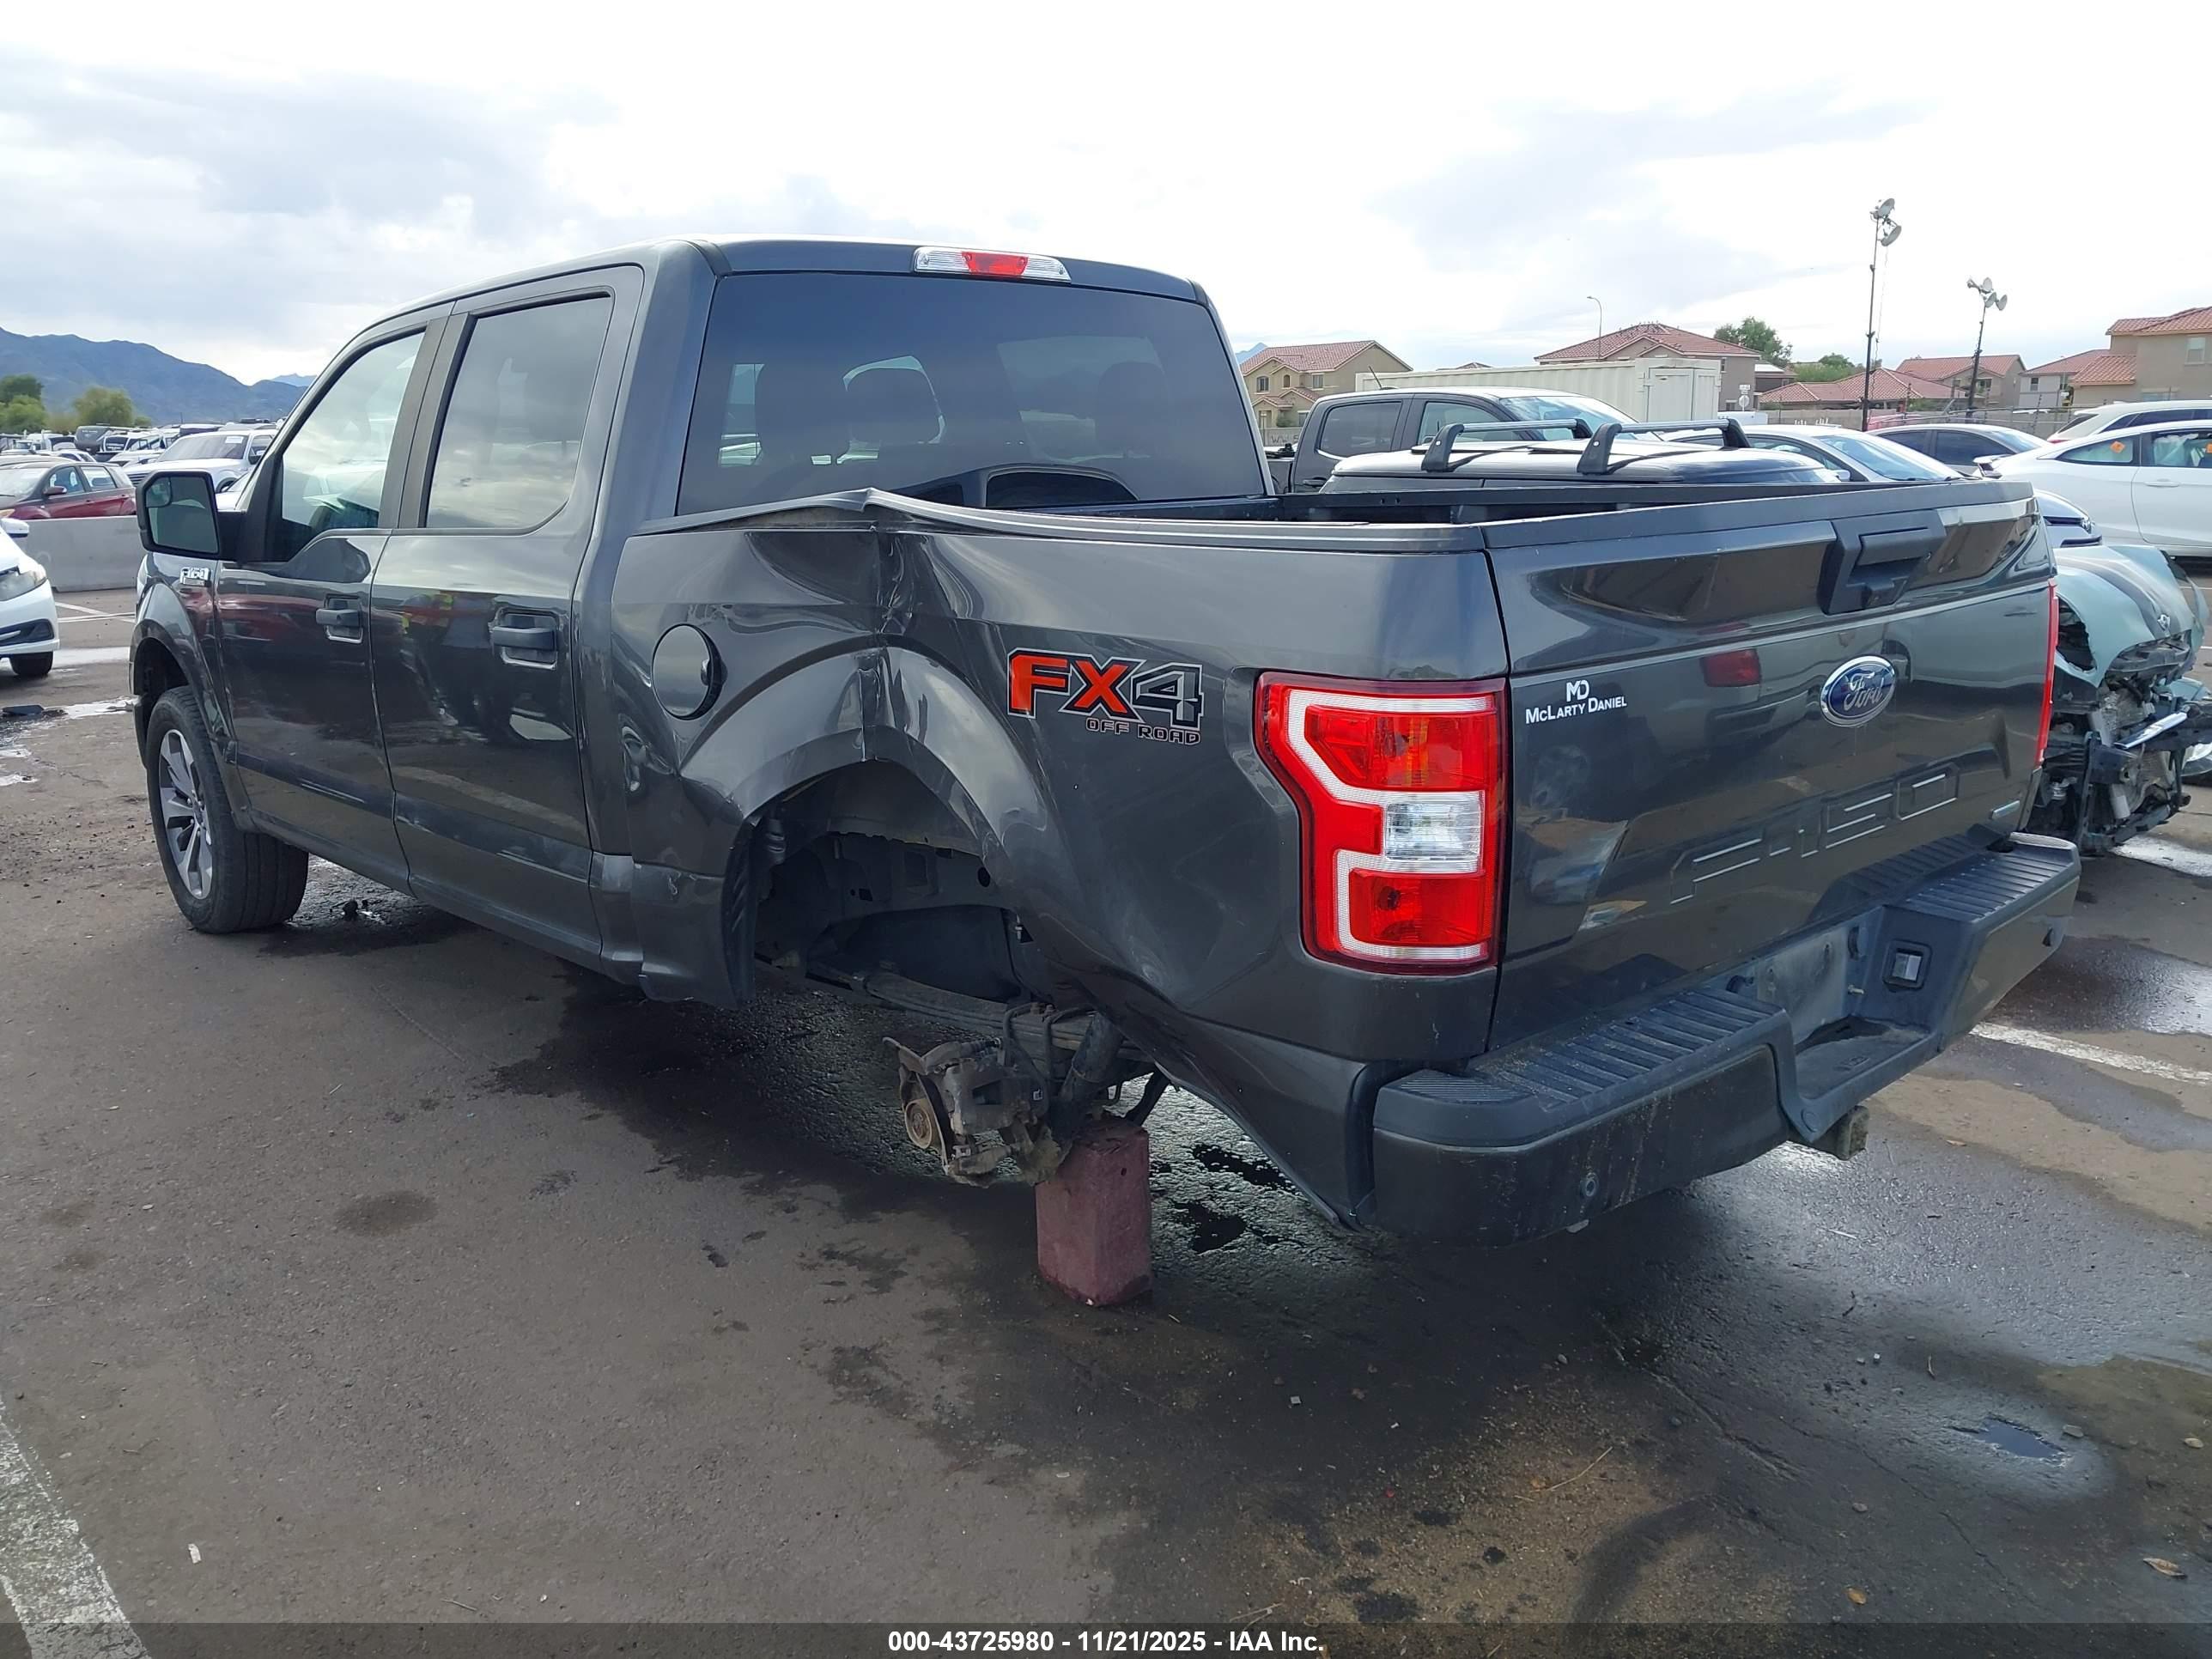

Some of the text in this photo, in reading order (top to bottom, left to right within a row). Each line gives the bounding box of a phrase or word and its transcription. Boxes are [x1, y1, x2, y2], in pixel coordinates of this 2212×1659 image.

[1007, 647, 1204, 731] FX4
[1565, 679, 1589, 702] MD
[1844, 672, 1883, 711] Ford
[1588, 696, 1627, 713] DANIEL
[1085, 717, 1200, 745] OFF ROAD
